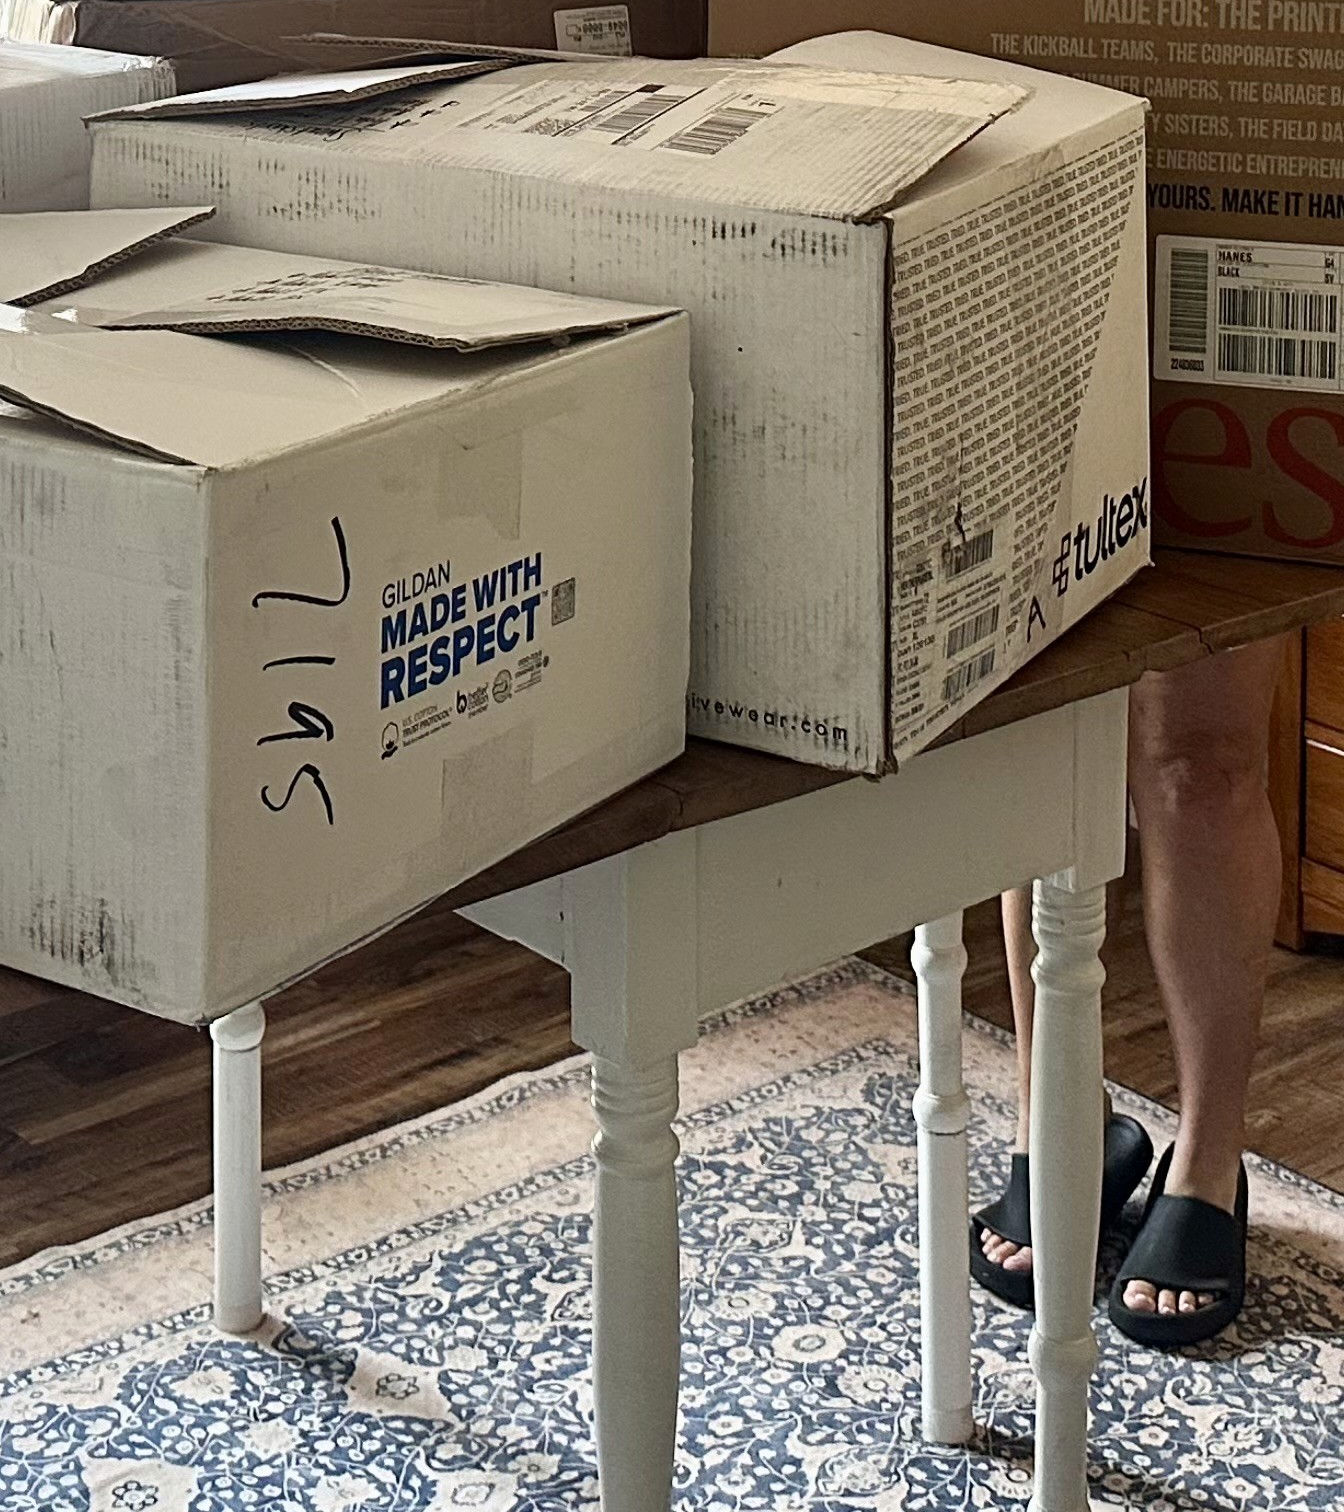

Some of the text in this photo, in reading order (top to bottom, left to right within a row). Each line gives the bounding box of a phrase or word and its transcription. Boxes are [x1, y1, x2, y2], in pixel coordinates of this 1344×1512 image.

[990, 32, 1020, 55] THE
[1023, 34, 1098, 59] KICKBALL
[1101, 39, 1158, 64] TEAMS,
[1167, 41, 1199, 64] THE
[1201, 43, 1295, 69] CORPORATE
[1143, 76, 1223, 105] CAMPERS,
[1227, 80, 1260, 103] THE
[1262, 81, 1327, 107] GARAGE
[1164, 113, 1234, 139] SISTERS,
[1237, 117, 1270, 139] THE
[1272, 118, 1318, 142] FIELD
[1157, 147, 1243, 174] ENERGETIC
[1147, 183, 1216, 212] YOURS.
[1221, 186, 1280, 216] MAKE
[1284, 191, 1304, 217] IT
[1217, 266, 1240, 278] BLACK
[1218, 250, 1253, 263] HANES
[1073, 476, 1148, 581] tultex
[382, 559, 451, 609] GILDAN
[381, 551, 542, 654] MADE WITH
[1026, 595, 1047, 644] A
